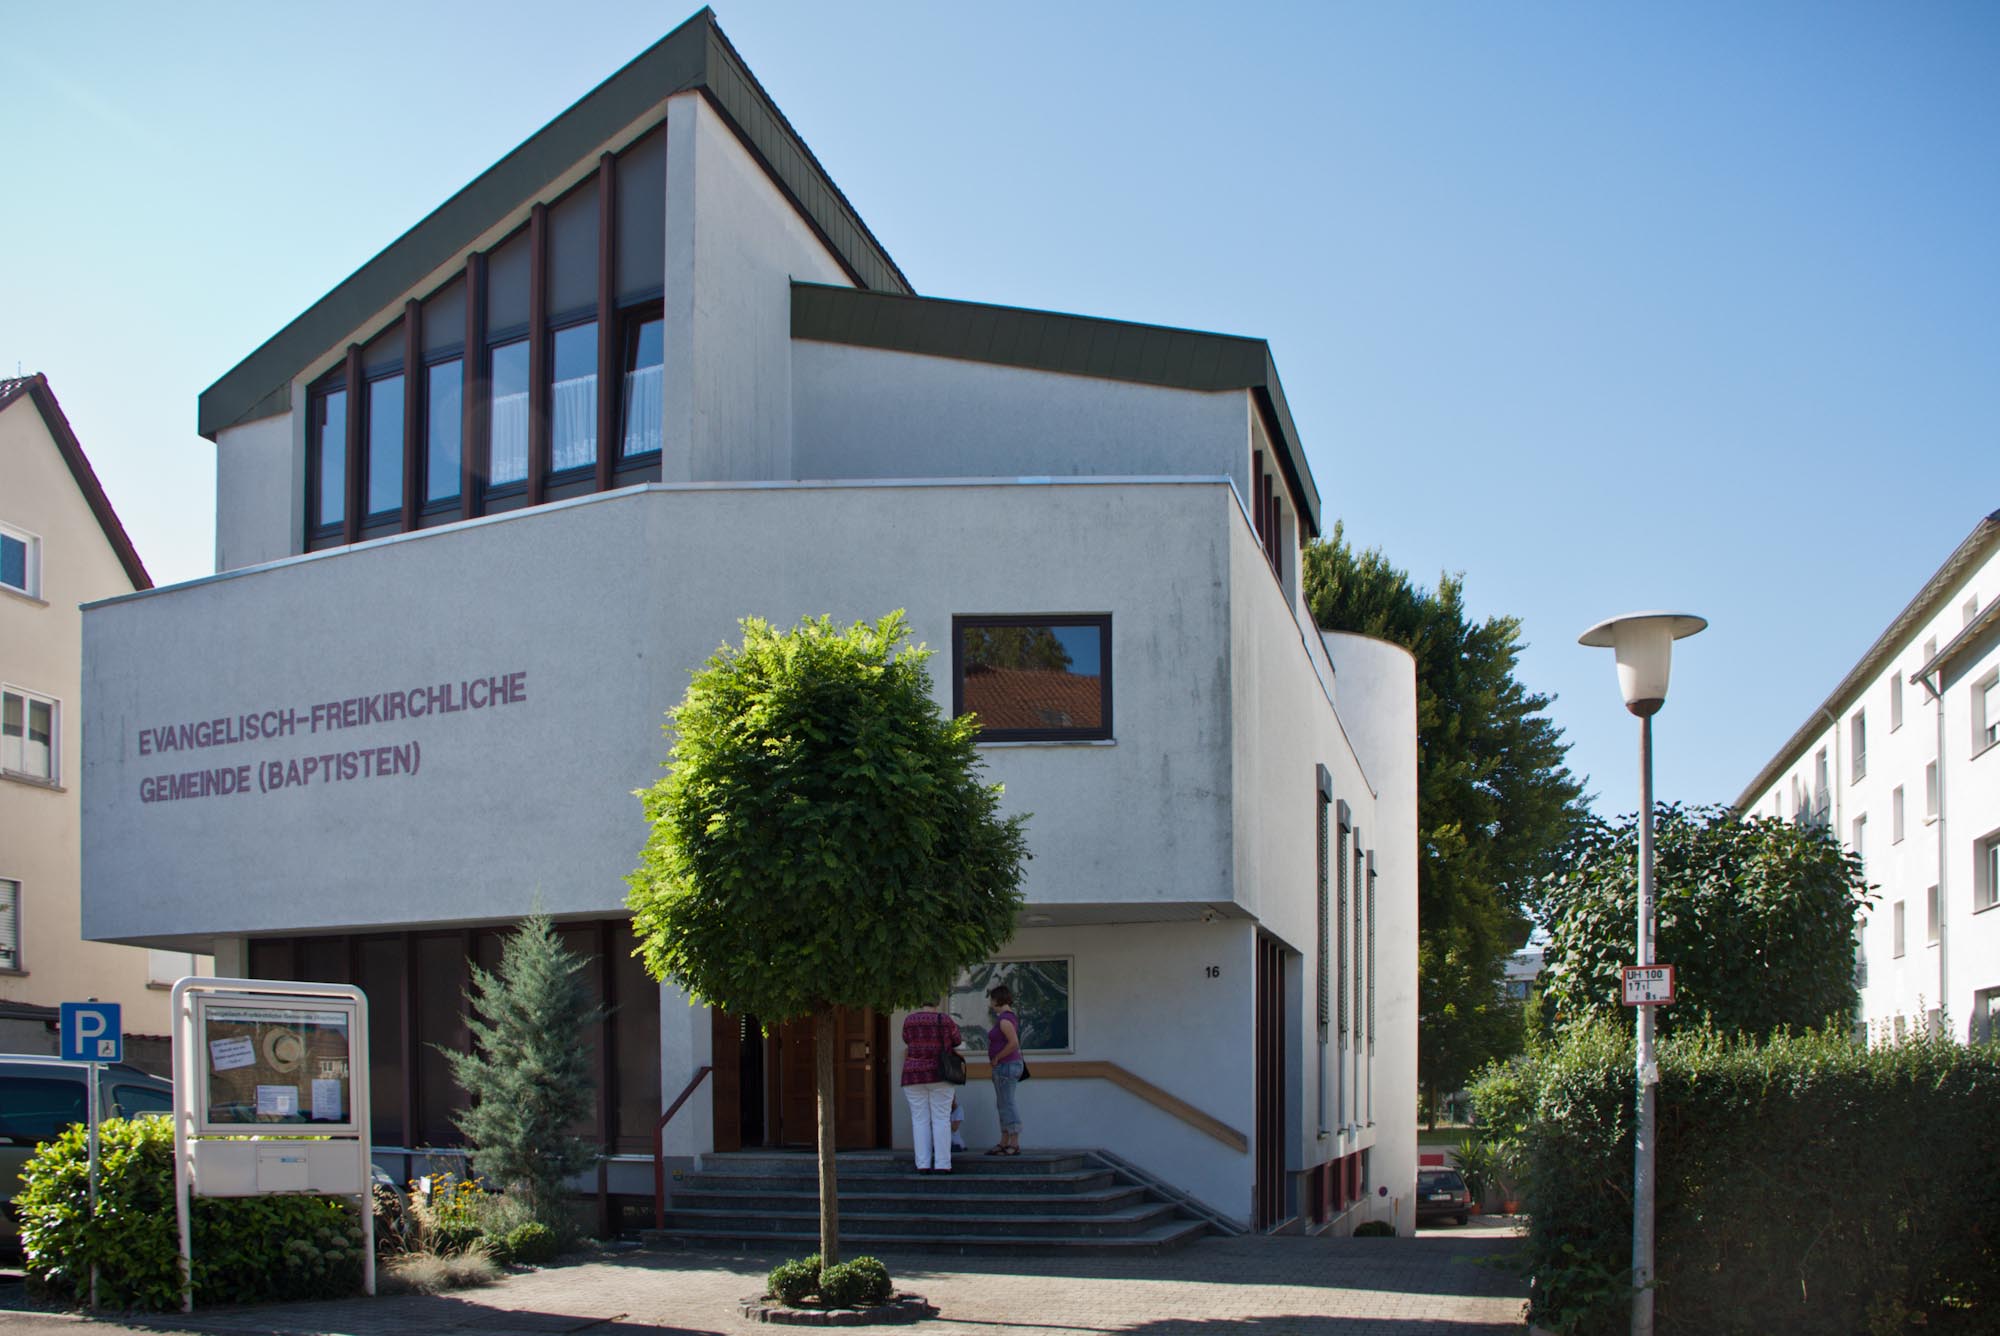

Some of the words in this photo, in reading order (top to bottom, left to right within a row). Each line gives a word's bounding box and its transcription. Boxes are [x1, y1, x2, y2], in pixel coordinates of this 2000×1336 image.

[139, 671, 527, 756] EVANGELISCH-FREIKIRCHLICHE
[140, 764, 251, 803] GEMEINDE
[258, 740, 421, 794] (BAPTISTEN)
[1206, 966, 1220, 978] 16
[1627, 970, 1641, 979] UH
[1645, 970, 1663, 979] 100
[75, 1010, 106, 1054] P
